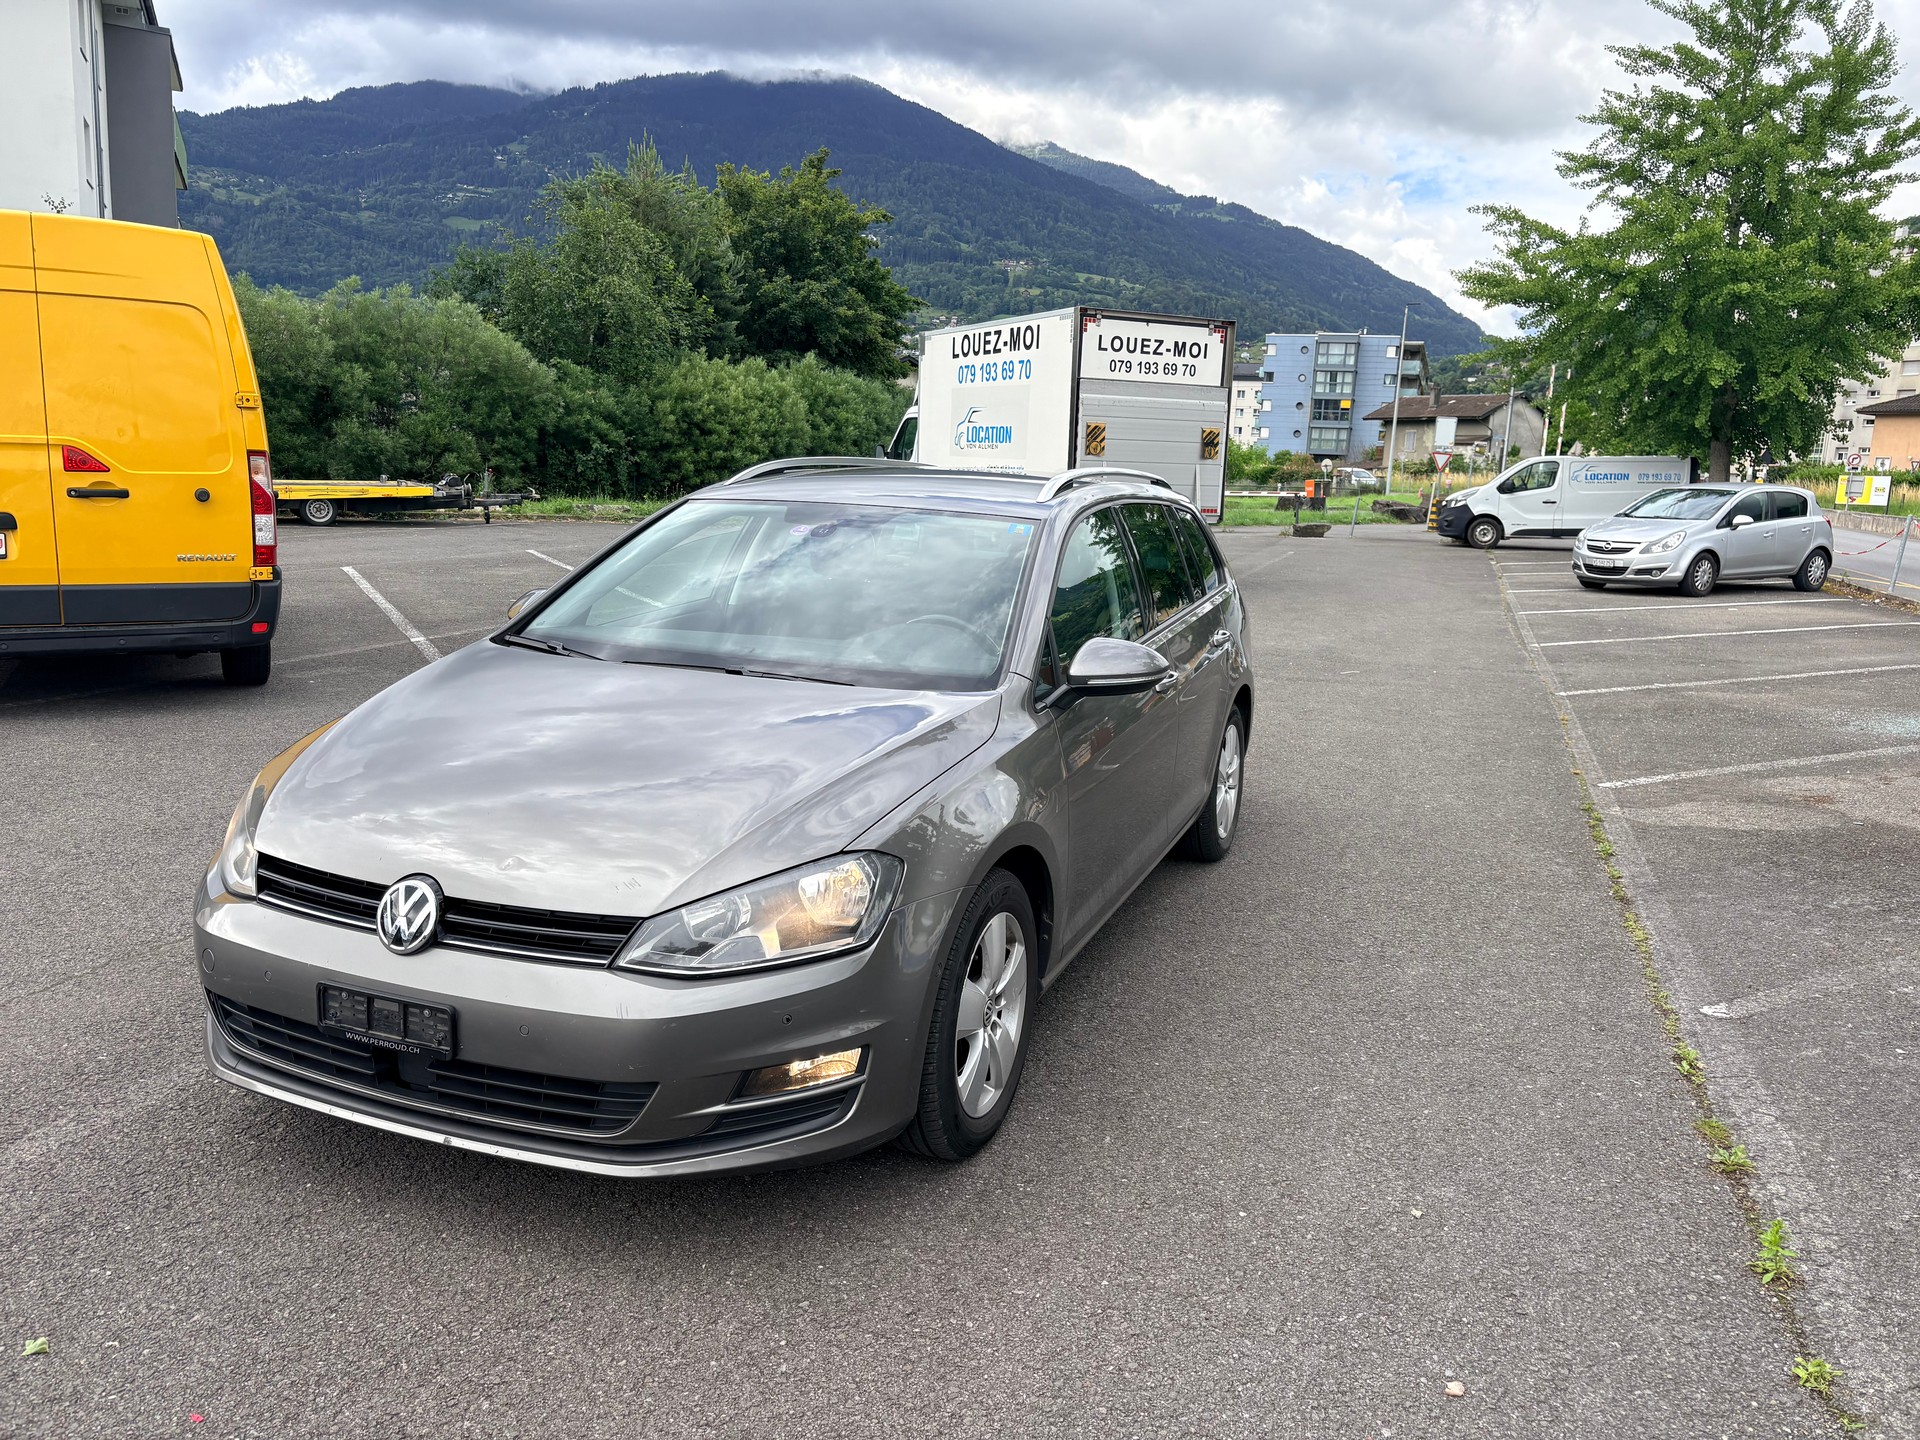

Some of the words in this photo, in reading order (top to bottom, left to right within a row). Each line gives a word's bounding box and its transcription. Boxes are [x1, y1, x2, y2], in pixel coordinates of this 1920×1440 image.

[952, 324, 1040, 359] LOUEZ-MOI
[1097, 334, 1208, 360] LOUEZ-MOI
[958, 364, 976, 384] 079
[980, 362, 998, 382] 193
[1002, 360, 1014, 381] 69
[1018, 359, 1032, 380] 70
[1109, 359, 1132, 373] 079
[1137, 361, 1159, 375] 193
[1163, 362, 1178, 376] 69
[1182, 364, 1196, 377] 70
[966, 425, 1012, 444] LOCATION
[1584, 473, 1630, 481] LOCATION
[1638, 473, 1650, 481] 079
[1651, 473, 1663, 481] 193
[1664, 473, 1672, 481] 69
[1674, 473, 1682, 481] 70
[176, 553, 238, 563] RENAULT
[345, 1031, 420, 1054] WWW.PERROUD.CH
